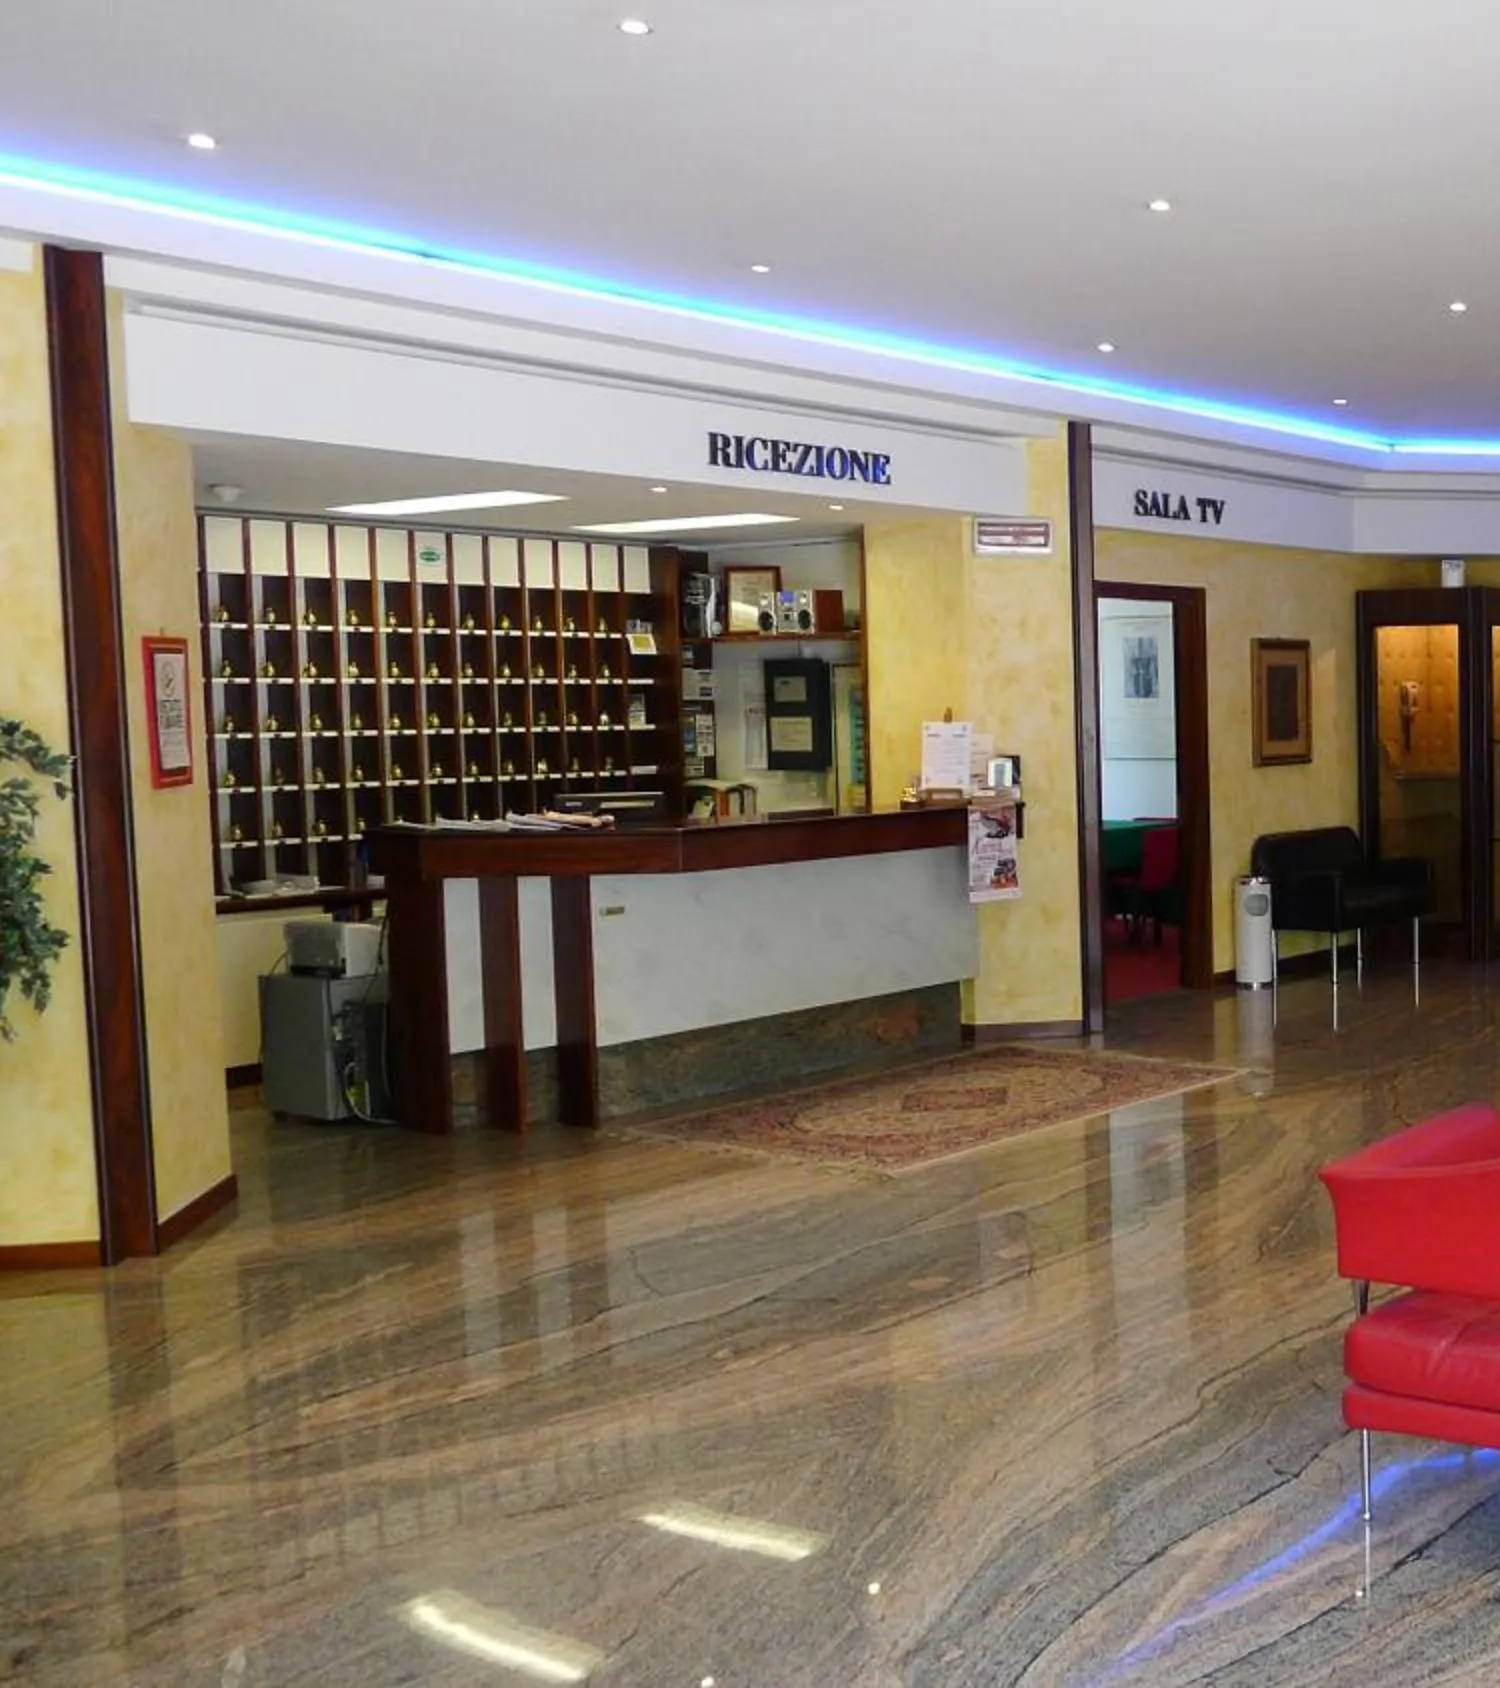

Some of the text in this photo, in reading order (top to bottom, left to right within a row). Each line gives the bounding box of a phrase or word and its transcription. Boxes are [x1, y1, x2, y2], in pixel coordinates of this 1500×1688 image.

[708, 432, 891, 485] RICEZIONE
[1134, 490, 1225, 524] SALA TV
